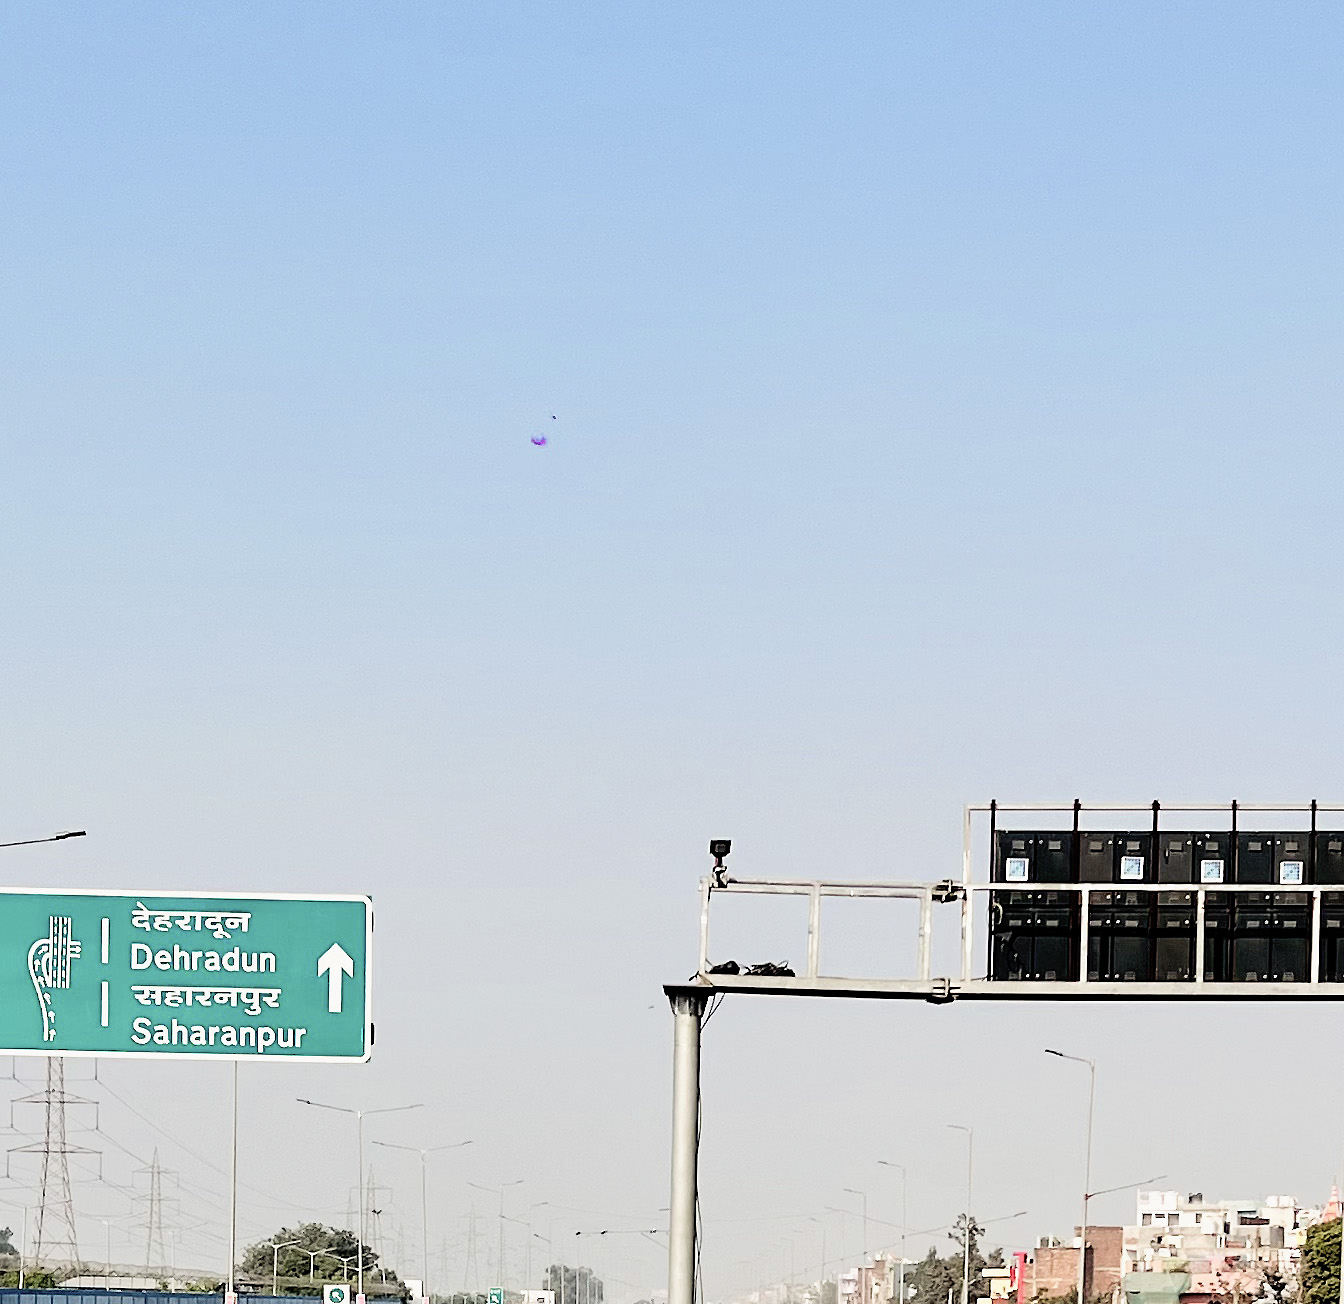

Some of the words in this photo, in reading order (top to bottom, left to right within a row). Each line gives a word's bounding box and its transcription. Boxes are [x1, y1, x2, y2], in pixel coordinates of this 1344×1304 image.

[131, 901, 252, 939] देहरादून
[130, 943, 276, 973] Dehradun
[130, 985, 282, 1015] सहारनपुर
[131, 1017, 307, 1053] Saharanpur
